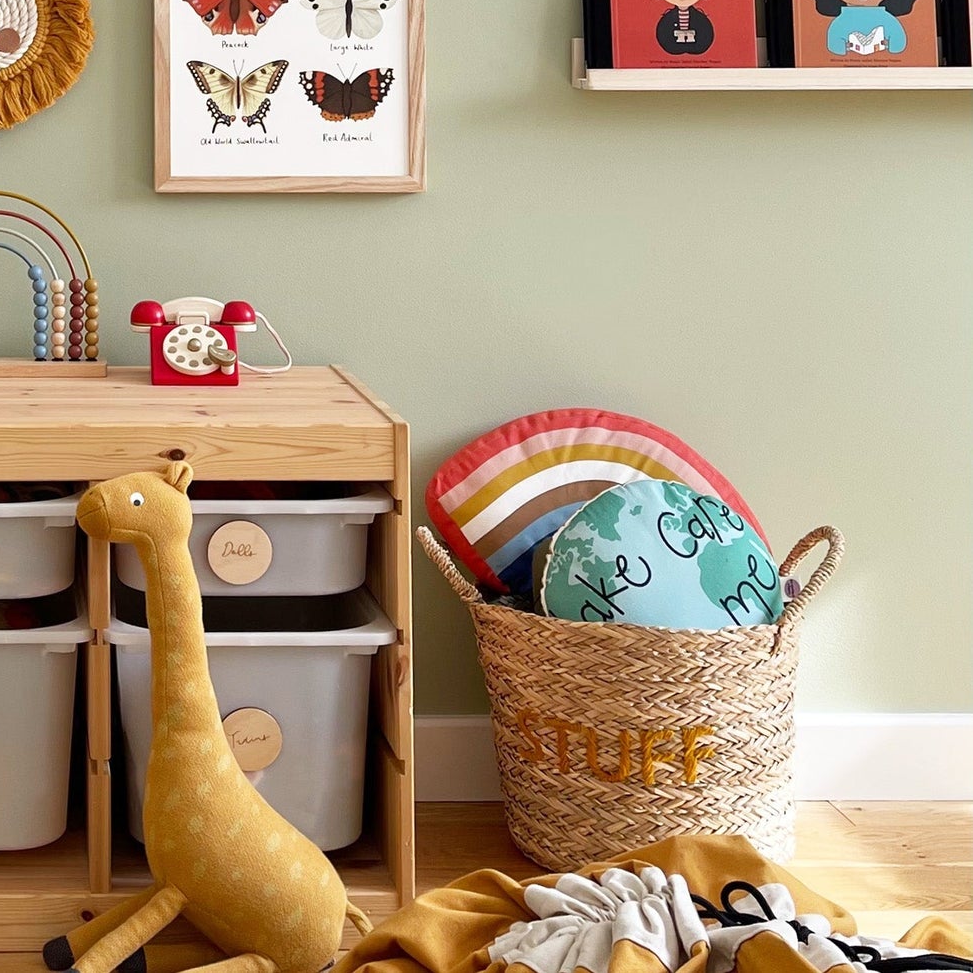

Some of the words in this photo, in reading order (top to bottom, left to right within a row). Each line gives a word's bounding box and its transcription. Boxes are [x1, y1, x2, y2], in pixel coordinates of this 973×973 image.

[221, 40, 249, 49] Peacock
[330, 43, 349, 55] Large
[354, 43, 374, 51] White
[200, 137, 212, 145] Old
[214, 137, 233, 145] World
[236, 136, 280, 145] Swallowtail
[322, 132, 337, 142] Red
[340, 132, 373, 142] Admiral
[222, 541, 257, 558] Dolls
[549, 554, 652, 622] ake
[657, 494, 745, 559] Care
[719, 553, 777, 626] me
[516, 708, 719, 786] STUFF
